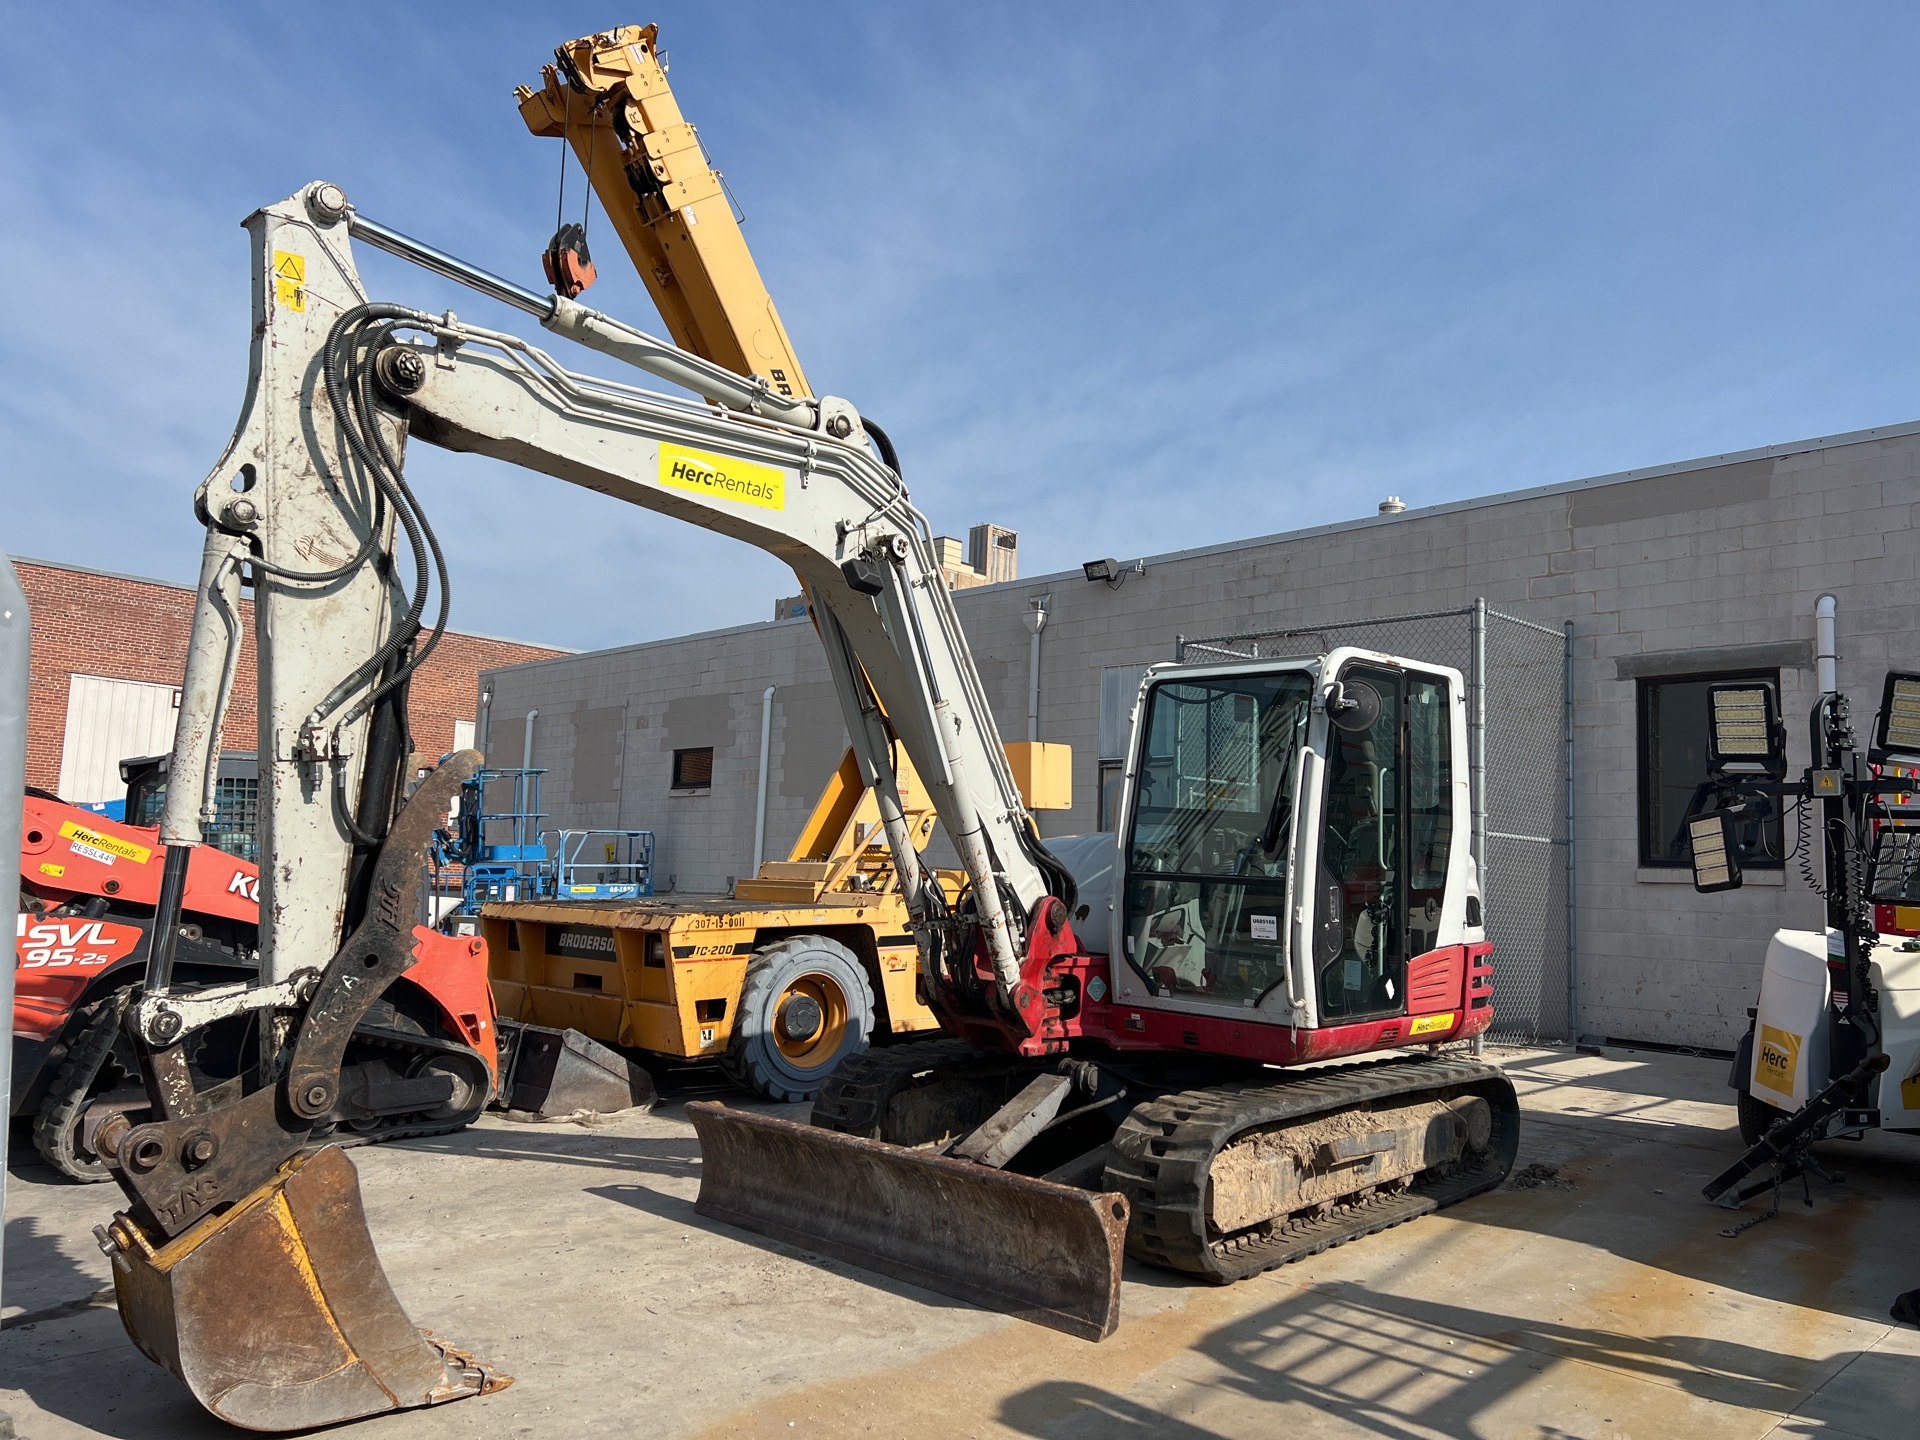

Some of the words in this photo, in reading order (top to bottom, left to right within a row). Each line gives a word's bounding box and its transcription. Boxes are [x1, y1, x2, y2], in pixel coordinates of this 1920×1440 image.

[770, 369, 794, 399] BR
[695, 917, 745, 929] 307-15-0011
[22, 923, 118, 949] SVL
[558, 932, 616, 952] BRODERSO
[1762, 1046, 1788, 1070] Herc
[1767, 1065, 1786, 1078] Rentals
